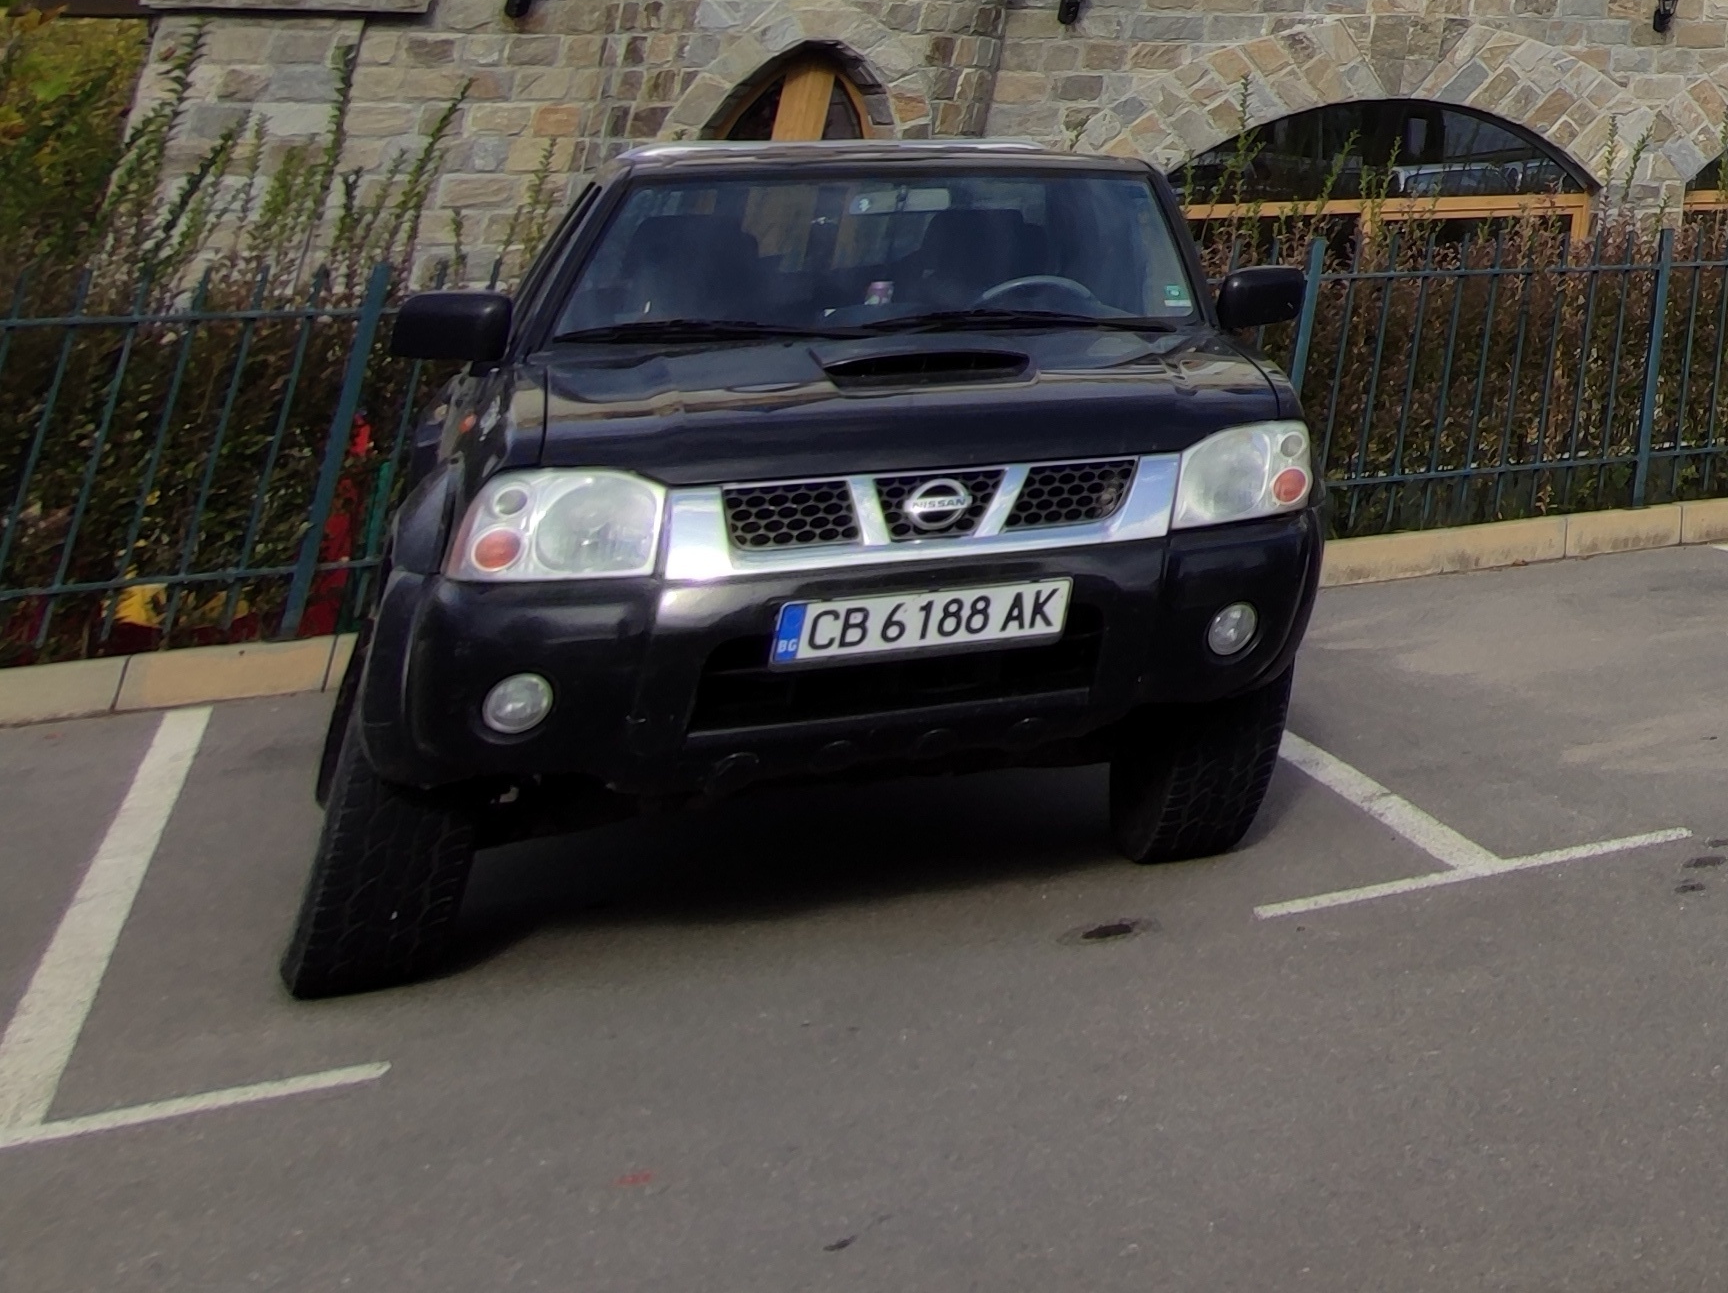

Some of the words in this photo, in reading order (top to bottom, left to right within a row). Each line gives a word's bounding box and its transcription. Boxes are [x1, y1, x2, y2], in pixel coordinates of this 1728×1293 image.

[911, 497, 967, 510] NISSAN
[808, 606, 870, 651] CB
[880, 594, 991, 644] 6188
[999, 587, 1060, 633] AK
[776, 638, 797, 653] BG
